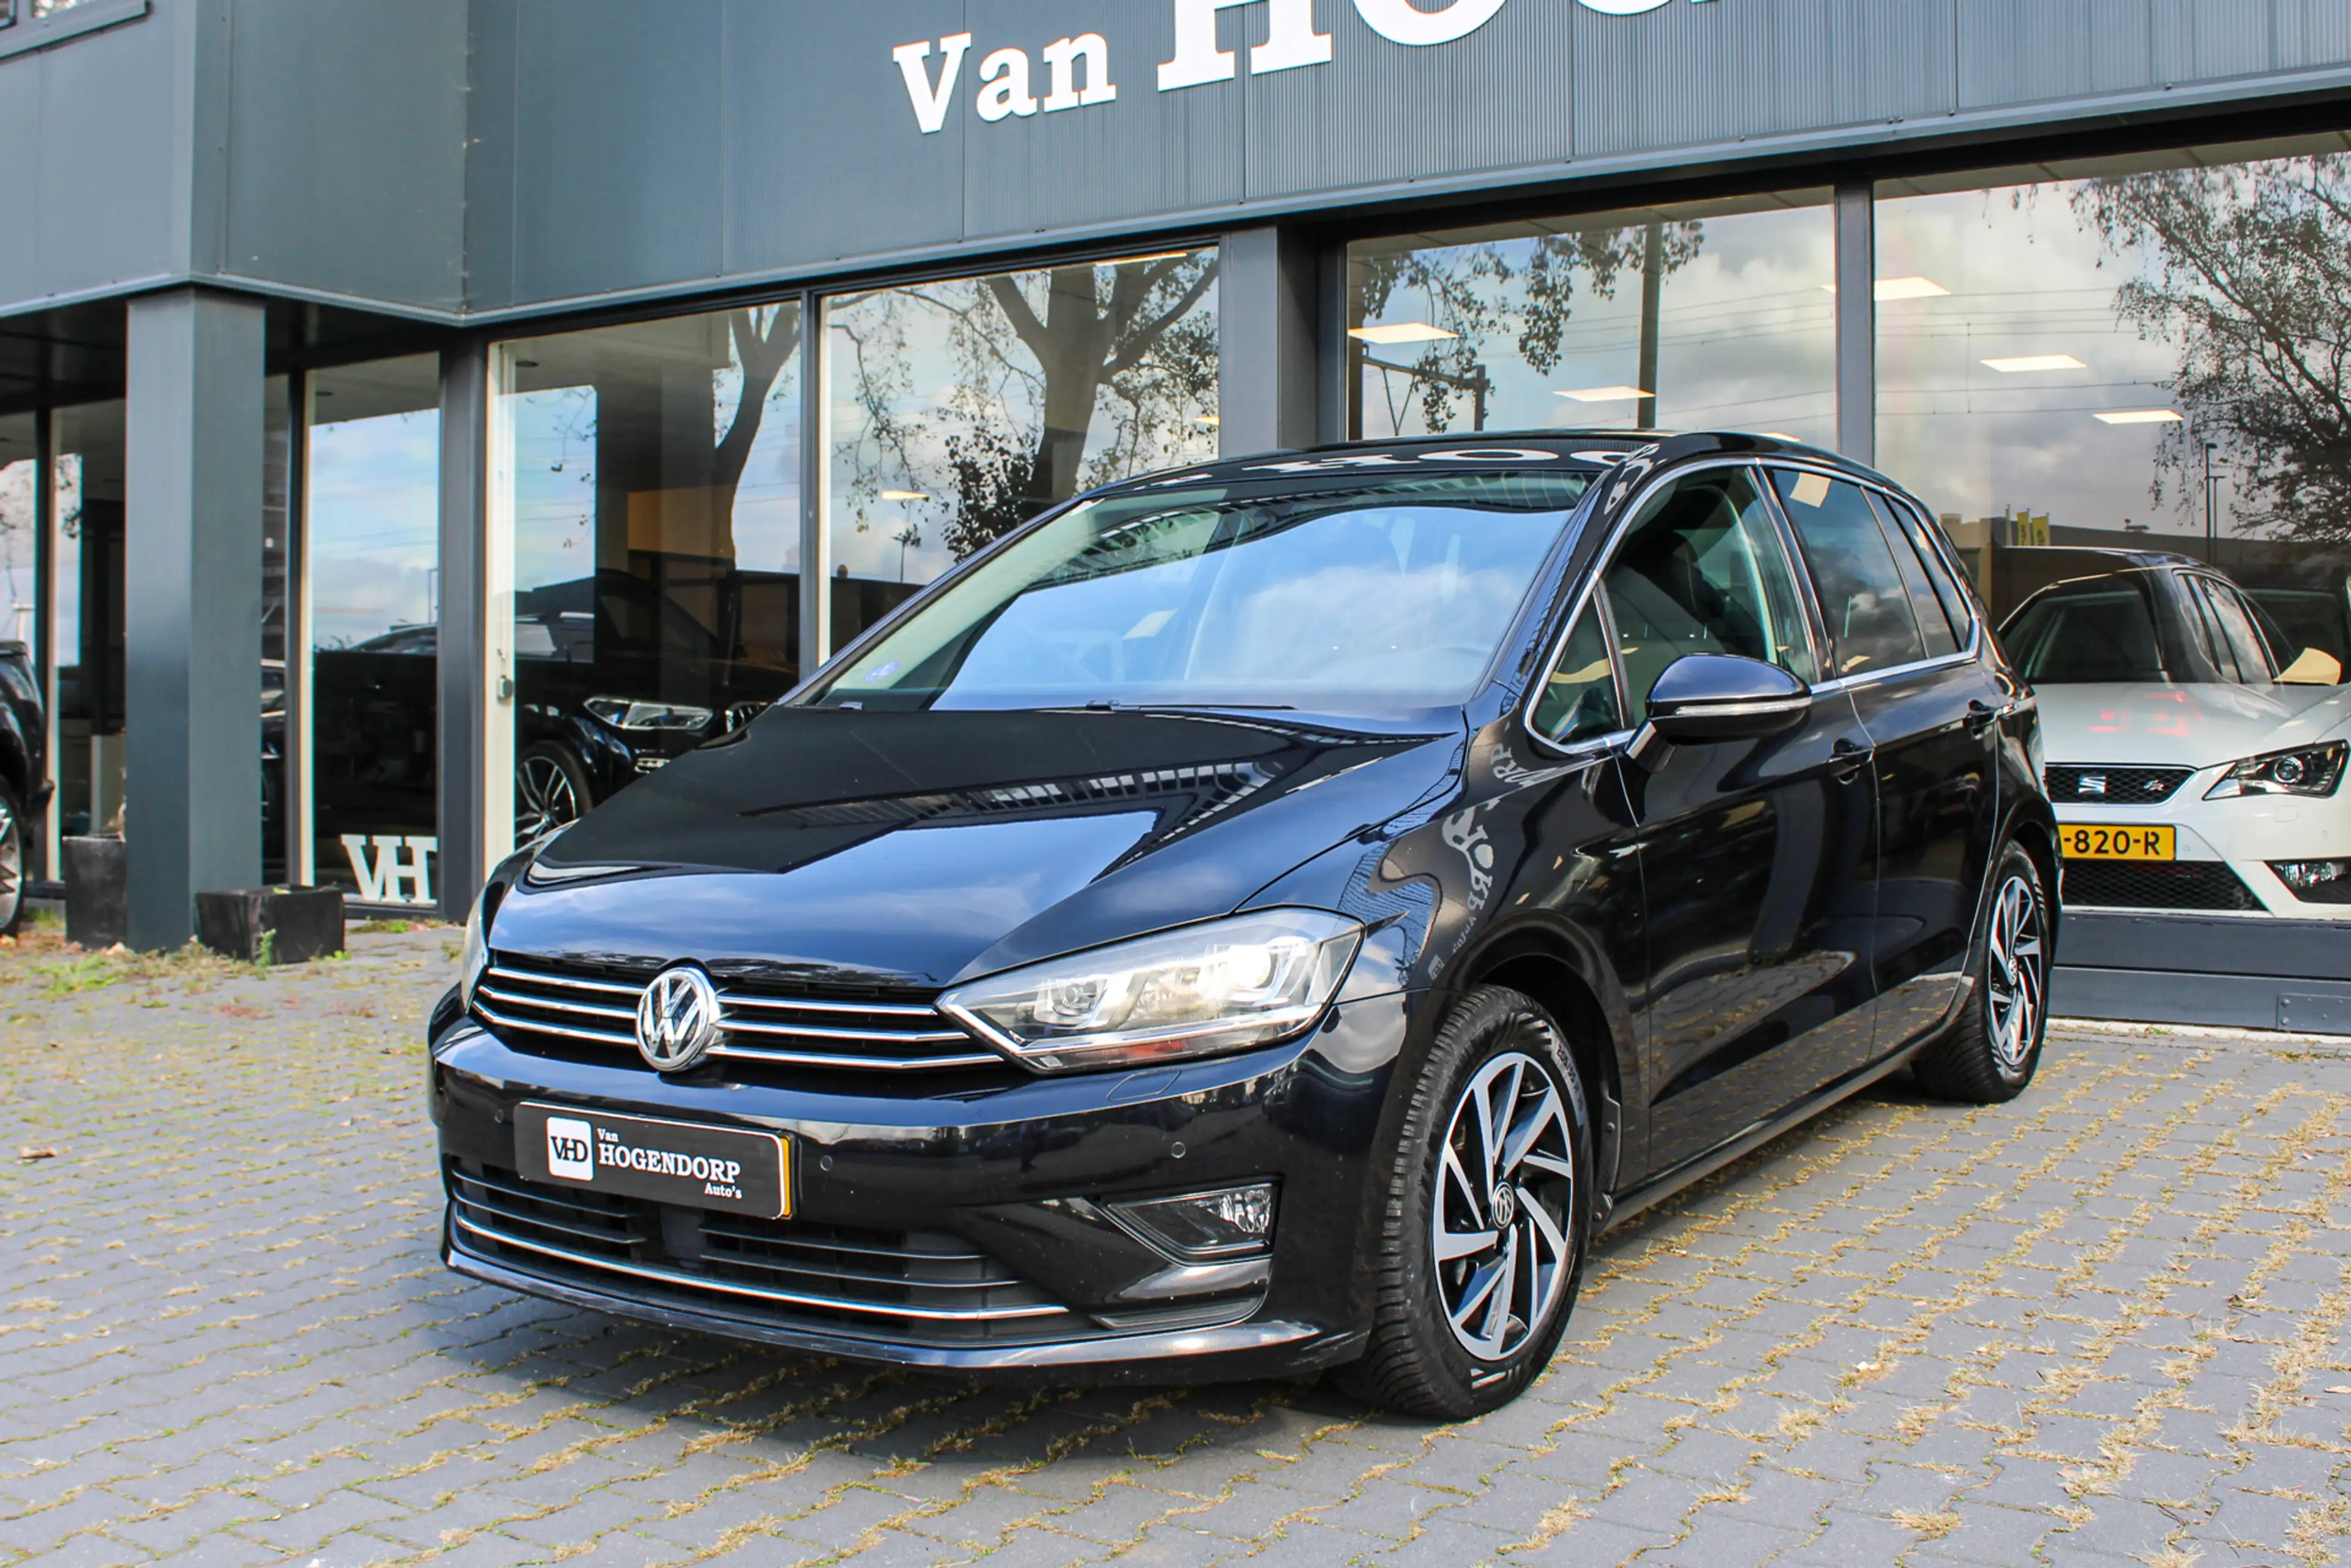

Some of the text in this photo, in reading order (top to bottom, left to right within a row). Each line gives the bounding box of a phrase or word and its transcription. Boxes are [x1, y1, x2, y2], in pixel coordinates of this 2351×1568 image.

[893, 32, 1116, 133] Van
[340, 834, 437, 905] VH
[598, 1128, 618, 1142] Van
[598, 1142, 741, 1182] HOGENDORP
[704, 1182, 742, 1199] Auto's
